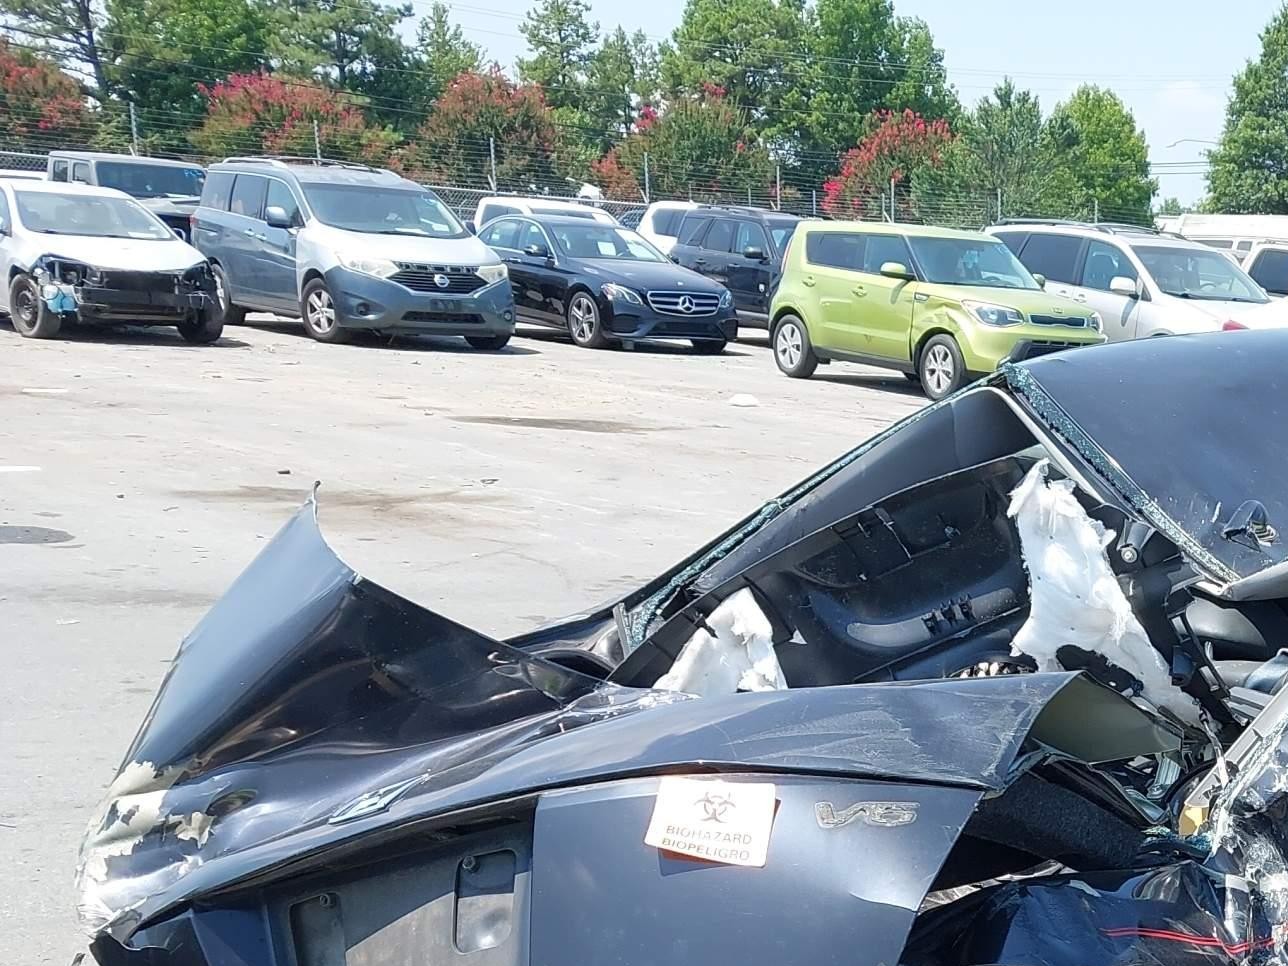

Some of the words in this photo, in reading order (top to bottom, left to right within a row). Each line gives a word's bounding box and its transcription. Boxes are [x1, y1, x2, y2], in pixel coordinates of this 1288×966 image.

[814, 801, 921, 829] V6
[665, 825, 753, 846] BIOHAZARD
[661, 837, 751, 861] BIOPELIGRO
